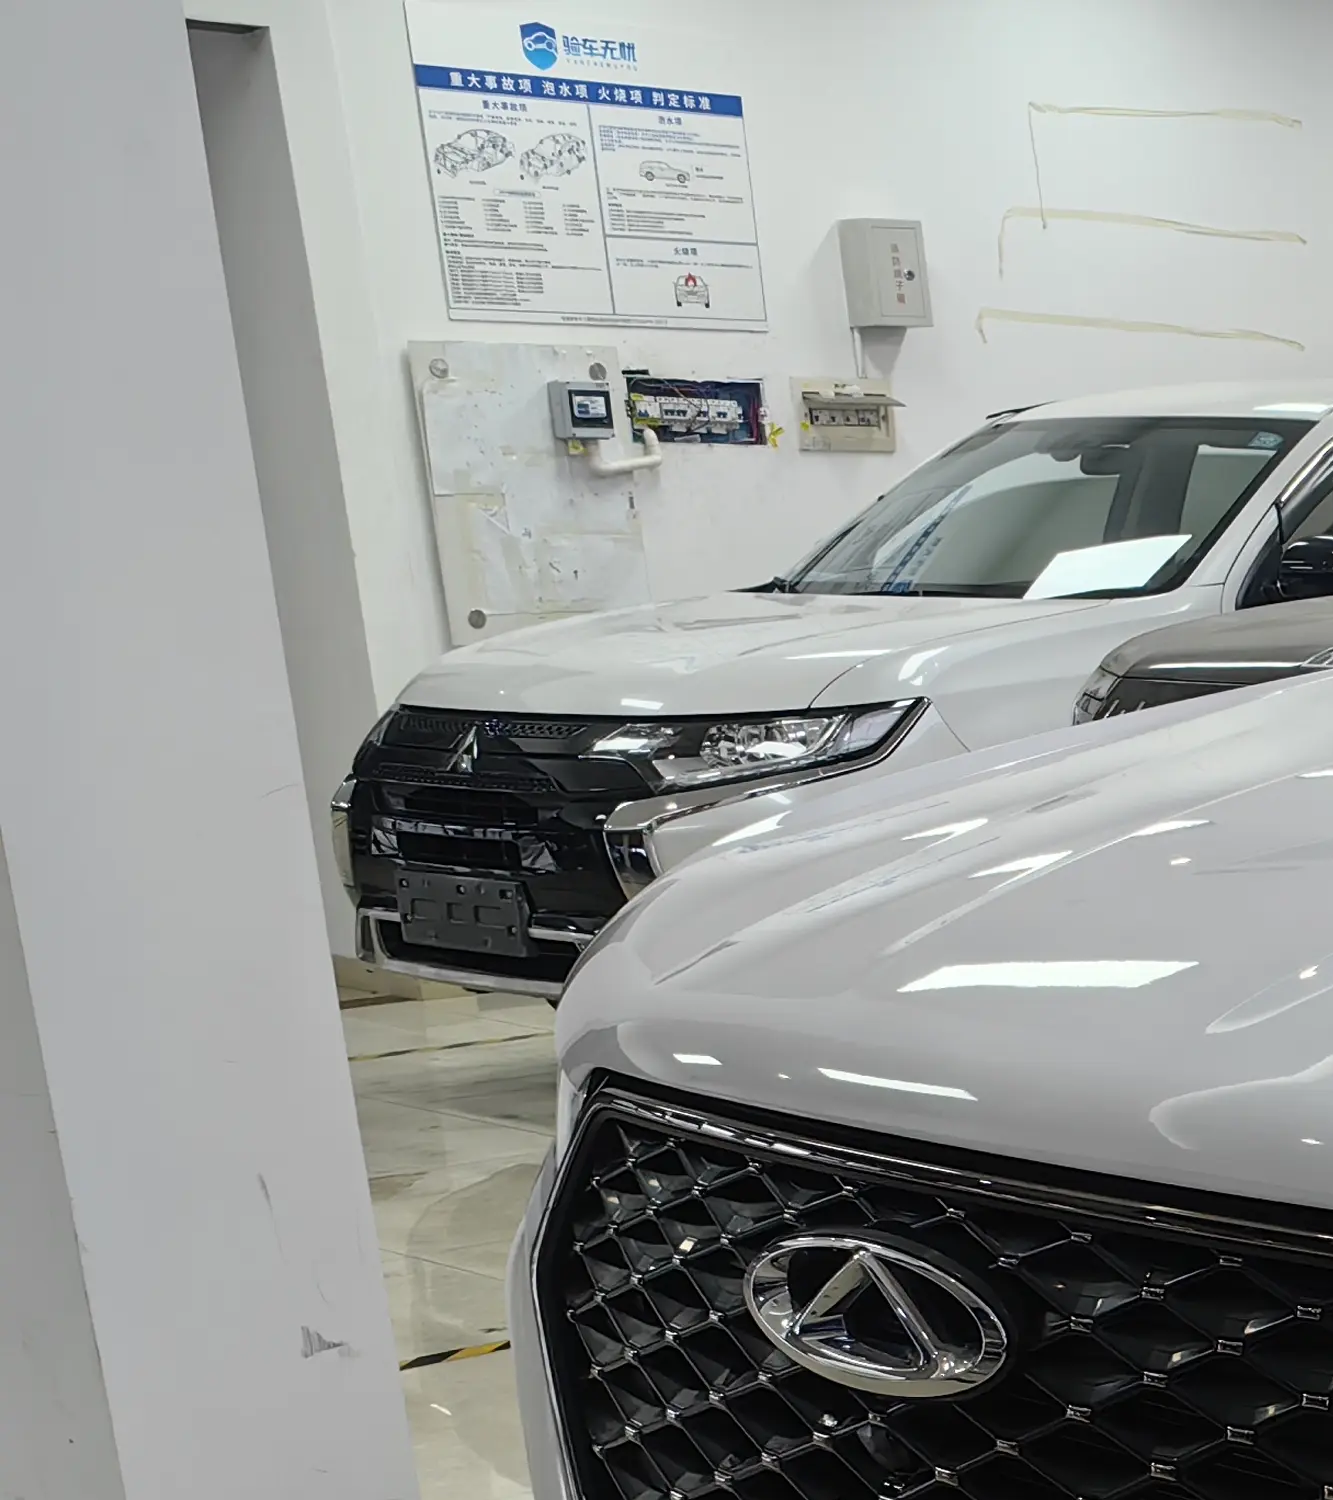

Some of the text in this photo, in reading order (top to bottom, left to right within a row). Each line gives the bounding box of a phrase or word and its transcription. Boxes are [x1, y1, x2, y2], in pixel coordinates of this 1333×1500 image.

[562, 35, 638, 62] 验车无忧
[449, 71, 712, 111] 重大事故项 泡水项 火烧项 判定标准
